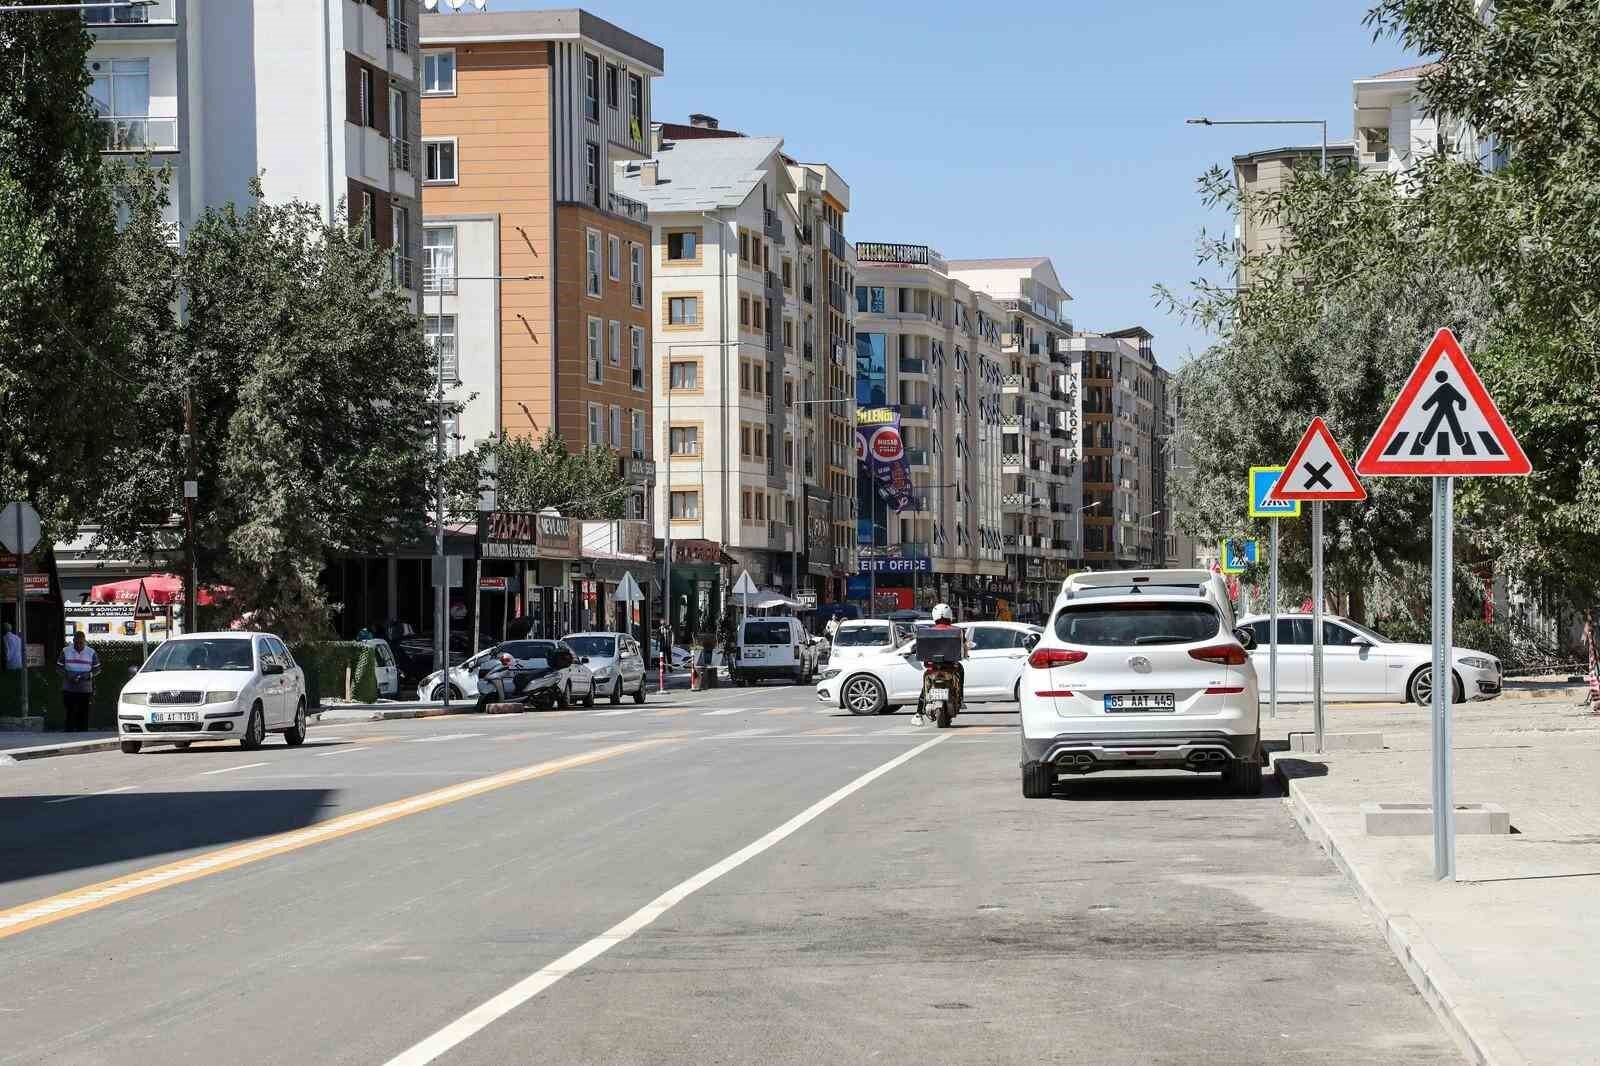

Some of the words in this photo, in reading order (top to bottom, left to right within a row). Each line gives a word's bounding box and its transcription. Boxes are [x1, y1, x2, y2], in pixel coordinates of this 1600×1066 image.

[857, 560, 885, 570] ENT
[889, 560, 926, 570] OFFICE
[1111, 695, 1124, 707] 65
[1131, 695, 1148, 707] AAT
[1154, 695, 1173, 707] 445
